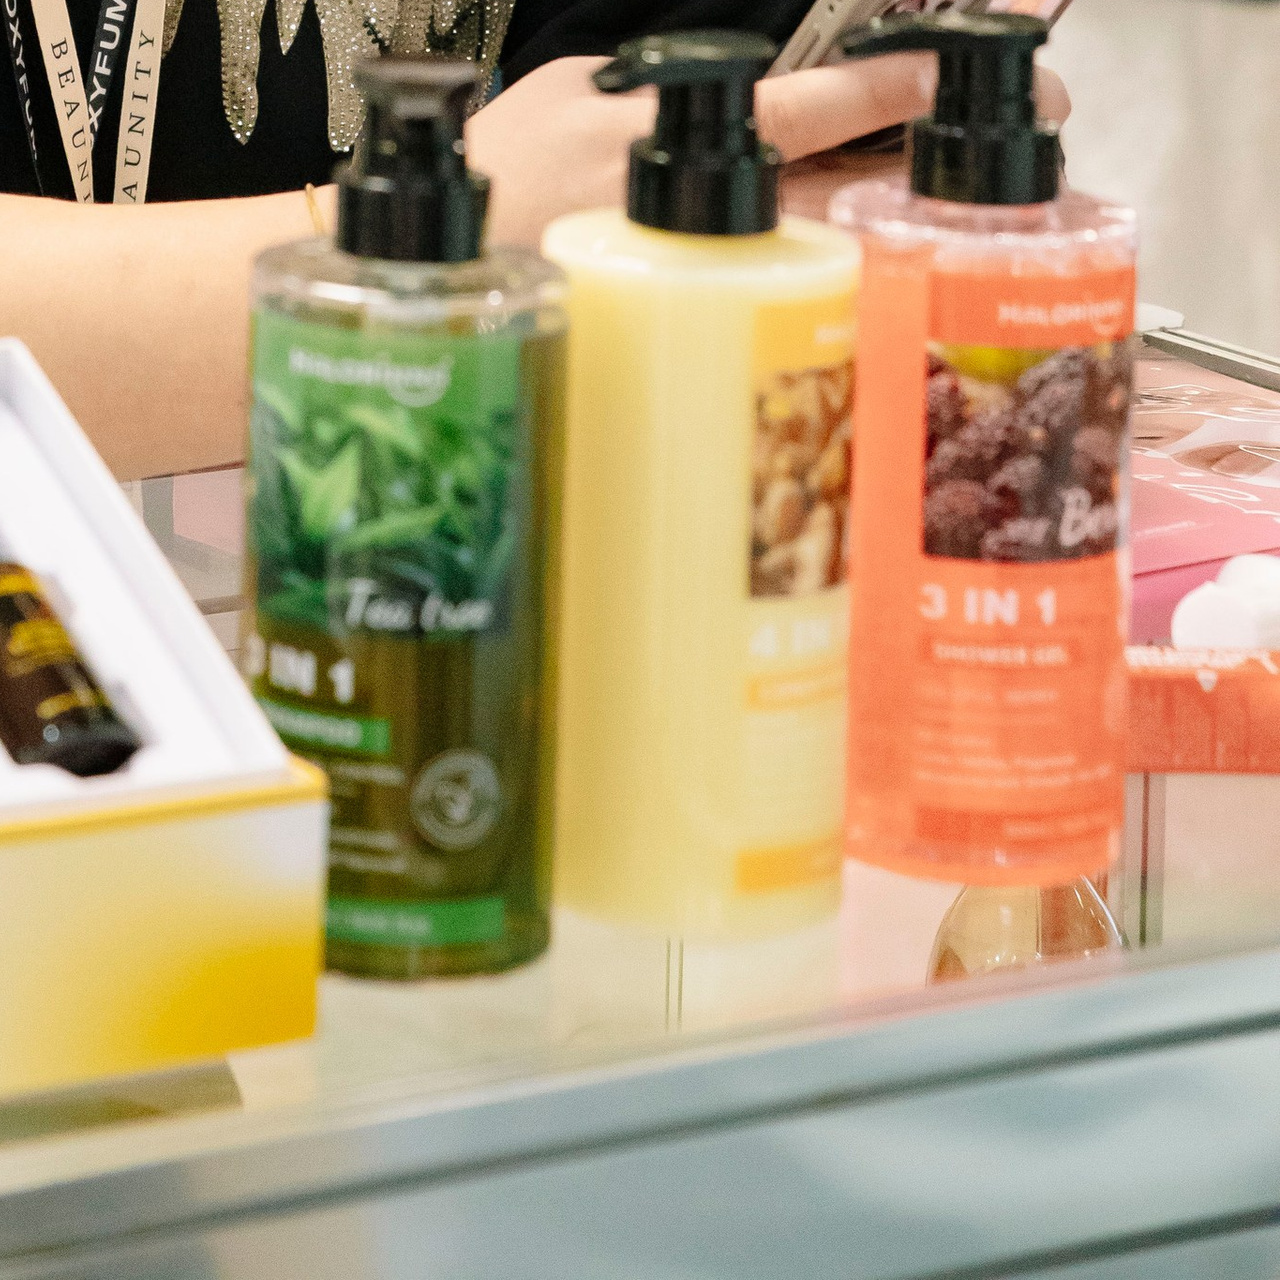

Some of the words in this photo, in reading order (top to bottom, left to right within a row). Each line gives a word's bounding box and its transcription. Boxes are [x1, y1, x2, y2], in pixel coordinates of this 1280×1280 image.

[50, 37, 92, 202] BEAUN
[122, 29, 156, 202] AUNITY
[920, 583, 948, 620] 3
[964, 587, 1020, 627] IN
[1035, 588, 1057, 627] 1
